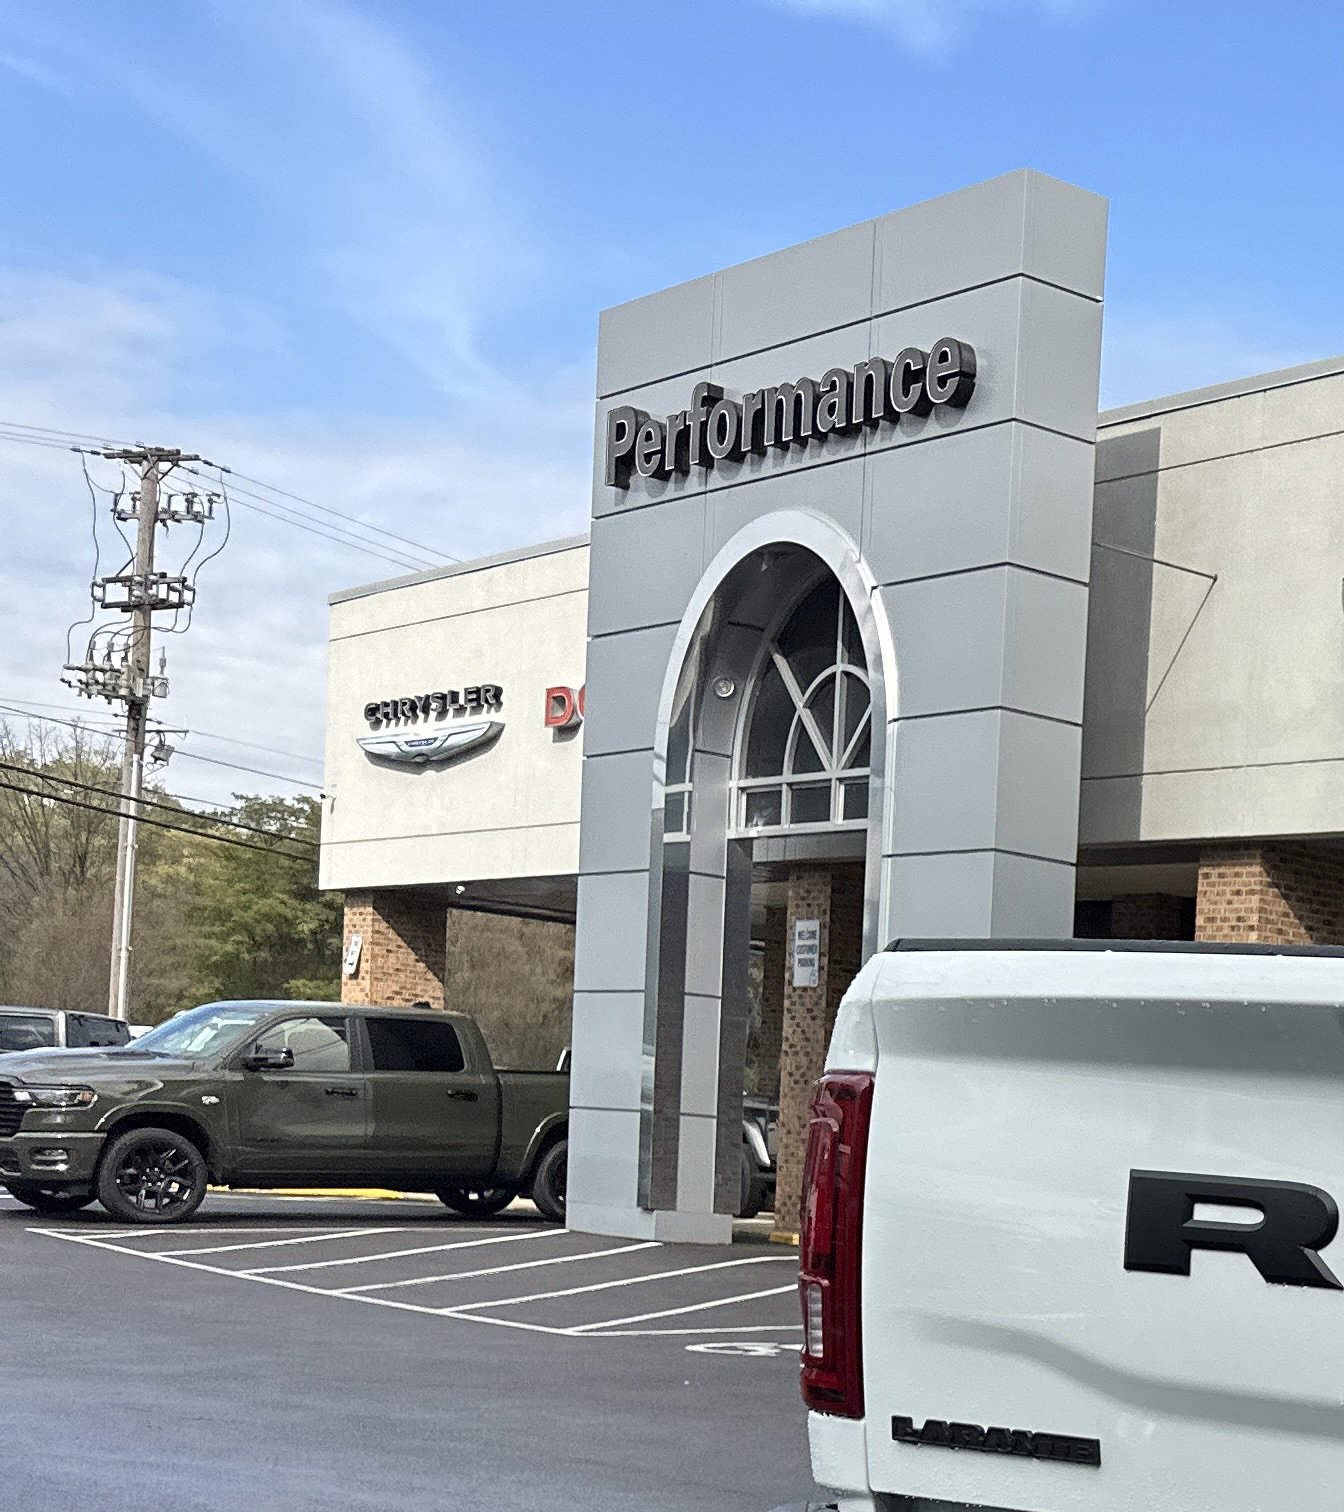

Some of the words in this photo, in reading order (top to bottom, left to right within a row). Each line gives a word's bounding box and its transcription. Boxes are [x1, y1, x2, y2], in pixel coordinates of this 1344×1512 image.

[605, 337, 977, 488] Performance
[364, 684, 503, 722] CHRYSLER
[544, 686, 586, 728] D
[891, 1414, 1102, 1466] LARAMIE
